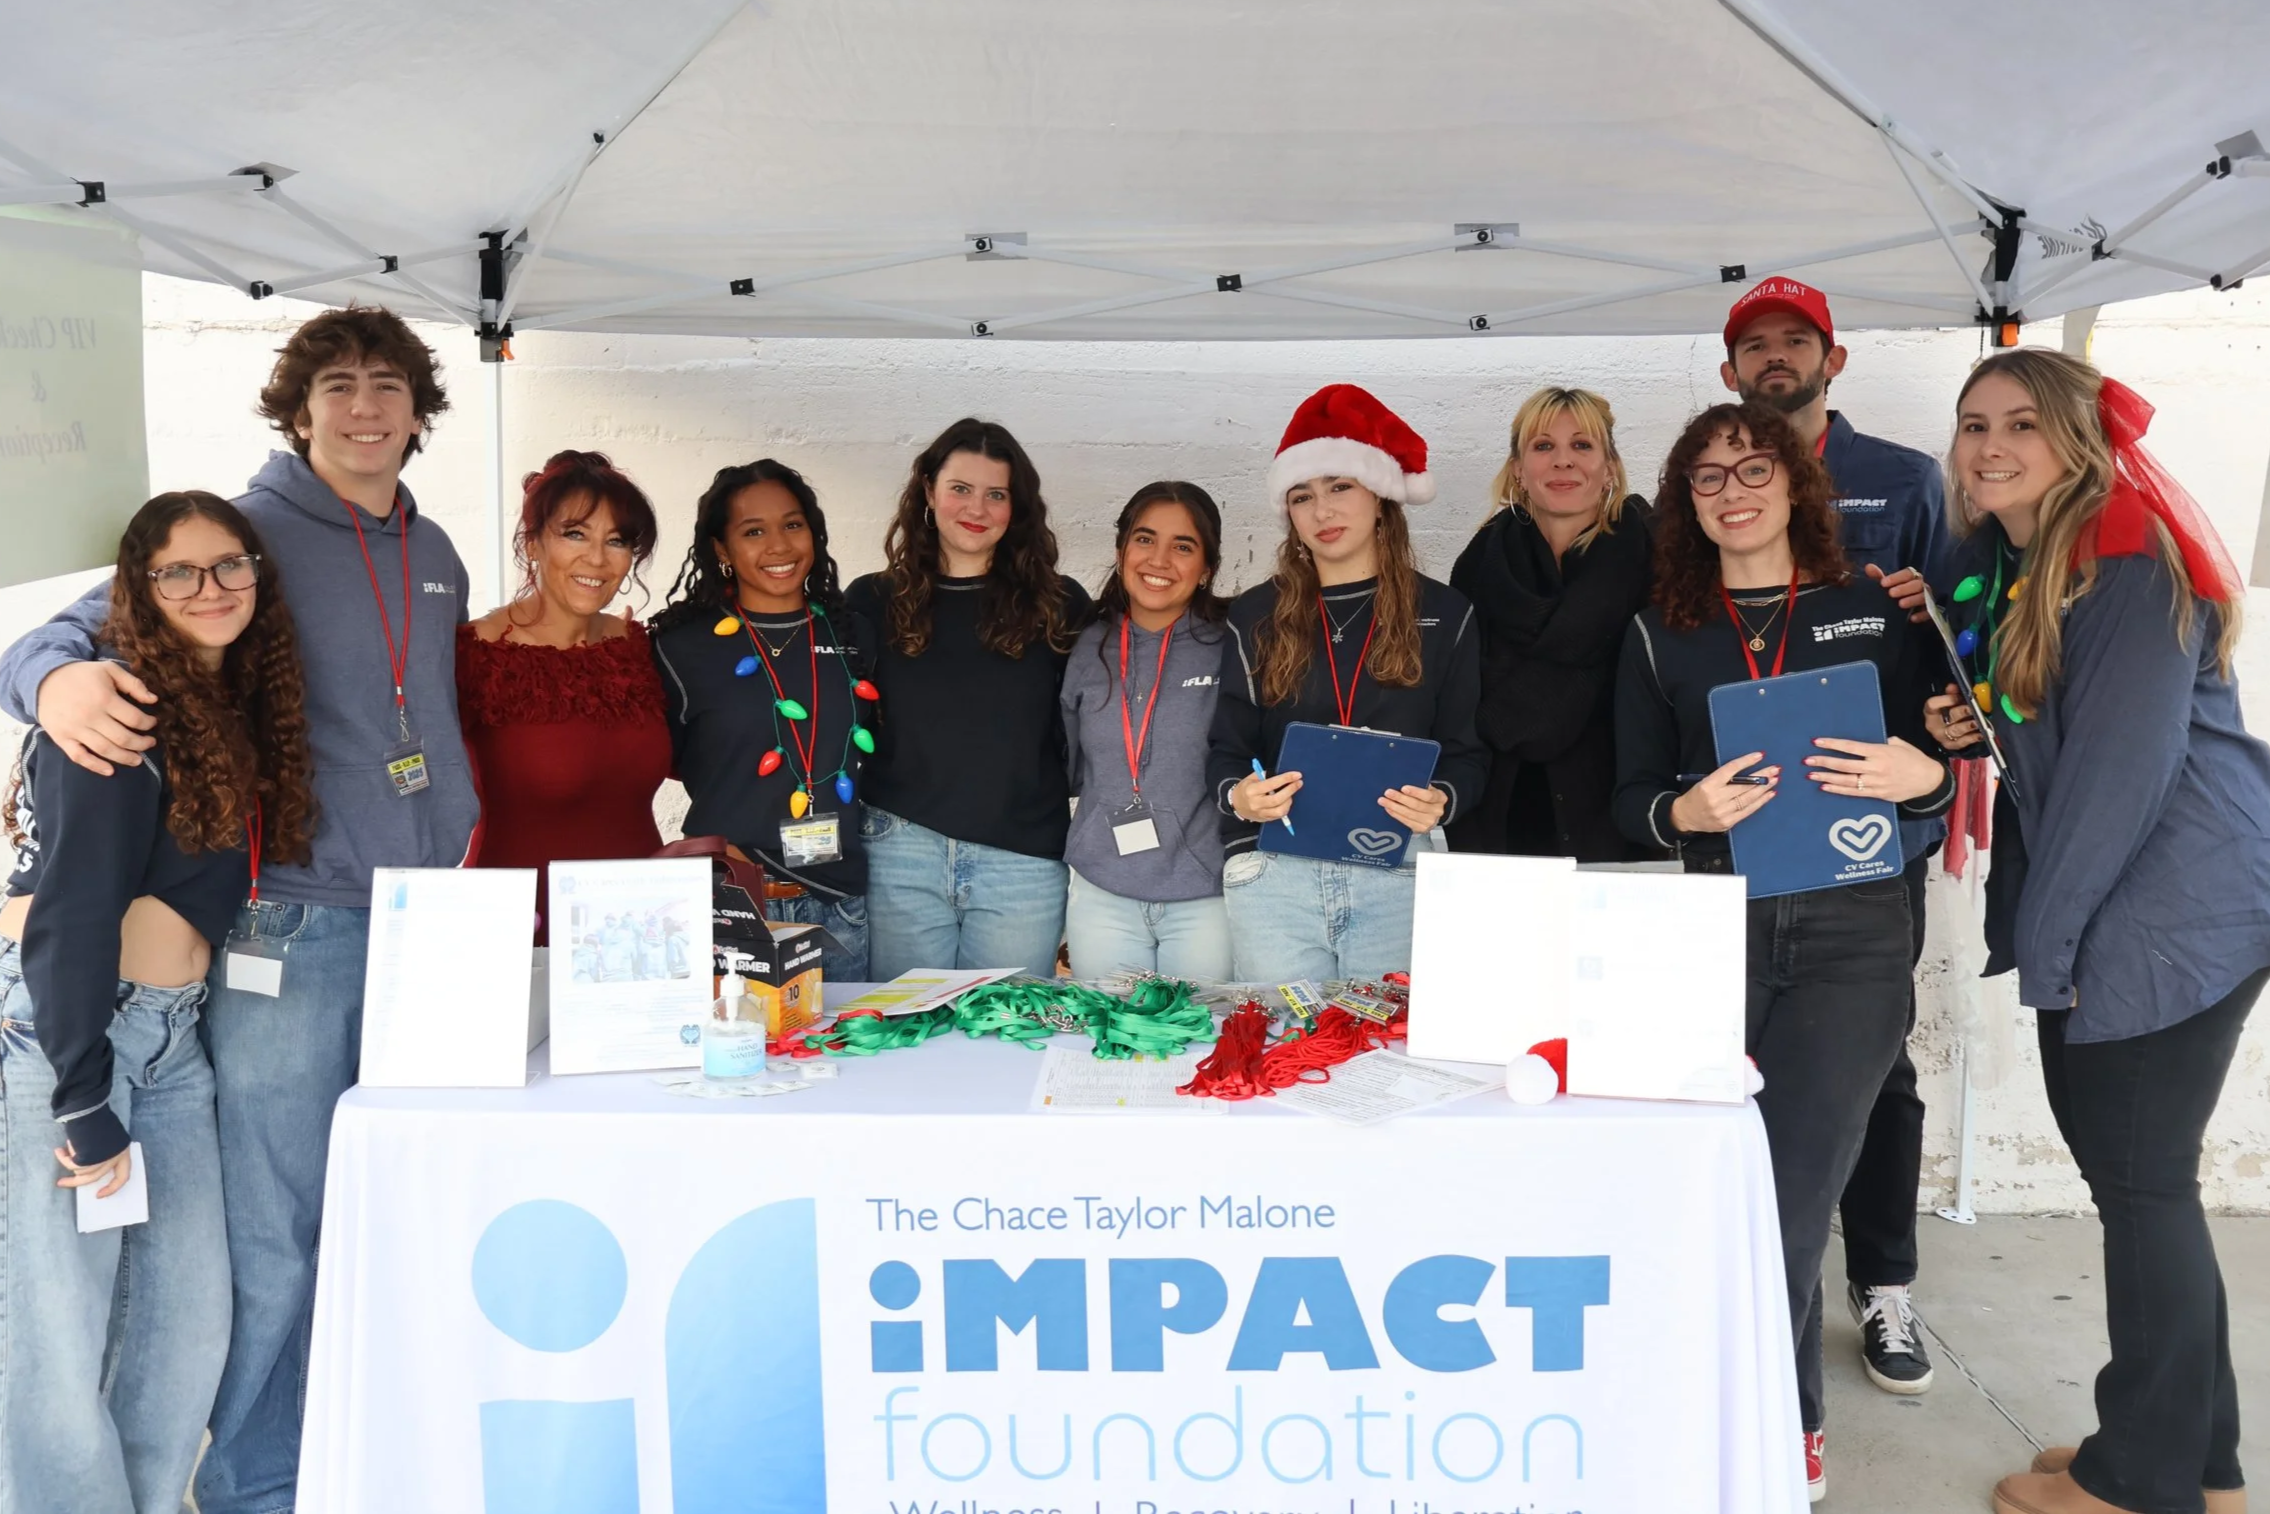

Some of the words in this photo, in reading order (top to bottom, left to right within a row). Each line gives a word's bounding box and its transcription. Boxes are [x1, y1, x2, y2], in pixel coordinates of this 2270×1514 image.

[1740, 283, 1776, 308] SANTA
[1783, 282, 1807, 297] HAT
[1835, 630, 1883, 638] foundation
[1341, 856, 1375, 865] Wellness
[1845, 863, 1858, 872] CV
[1859, 860, 1885, 869] Cares
[1835, 870, 1875, 880] Wellness
[1876, 866, 1894, 874] Fair
[721, 908, 756, 920] HAND
[717, 957, 771, 974] WRMER
[784, 958, 800, 971] HAND
[800, 948, 822, 964] WARMER
[788, 984, 800, 1001] 10
[730, 1048, 762, 1060] SANITIZER
[737, 1043, 758, 1051] HAND
[865, 1197, 938, 1231] The
[952, 1197, 1067, 1231] Chace
[1073, 1195, 1187, 1240] Taylor
[1199, 1195, 1336, 1229] Malone
[868, 1254, 1611, 1373] iMPACT
[873, 1385, 1584, 1484] foundation
